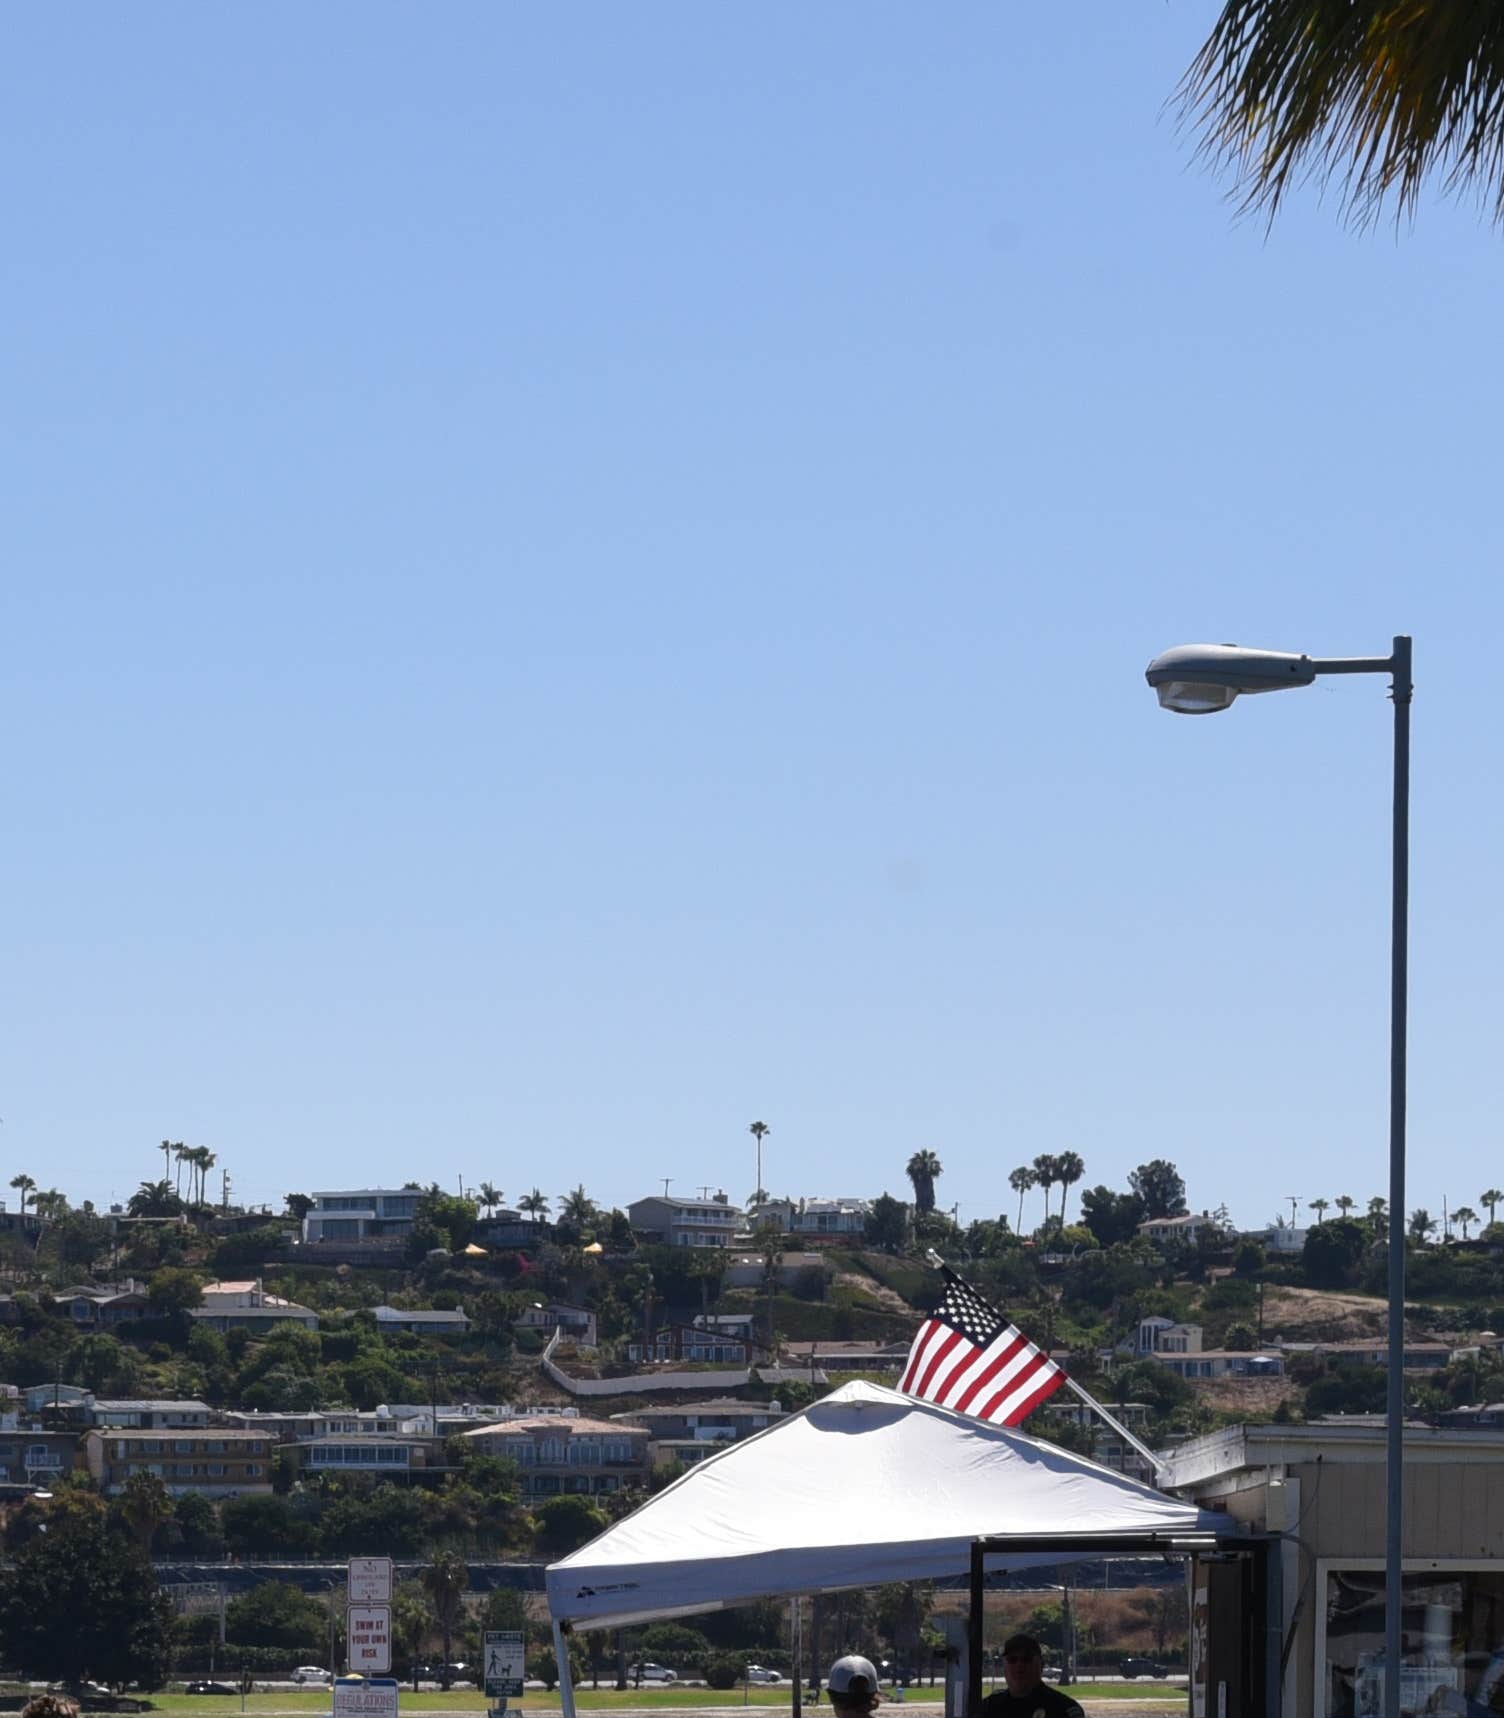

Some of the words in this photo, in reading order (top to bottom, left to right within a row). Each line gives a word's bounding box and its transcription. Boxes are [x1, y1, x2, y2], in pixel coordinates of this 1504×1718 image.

[355, 1620, 374, 1631] SWIM
[375, 1620, 383, 1631] AT
[352, 1634, 370, 1644] YOUR
[371, 1634, 387, 1644] OWN
[361, 1647, 377, 1658] RISK
[335, 1694, 395, 1706] REGULATIONS
